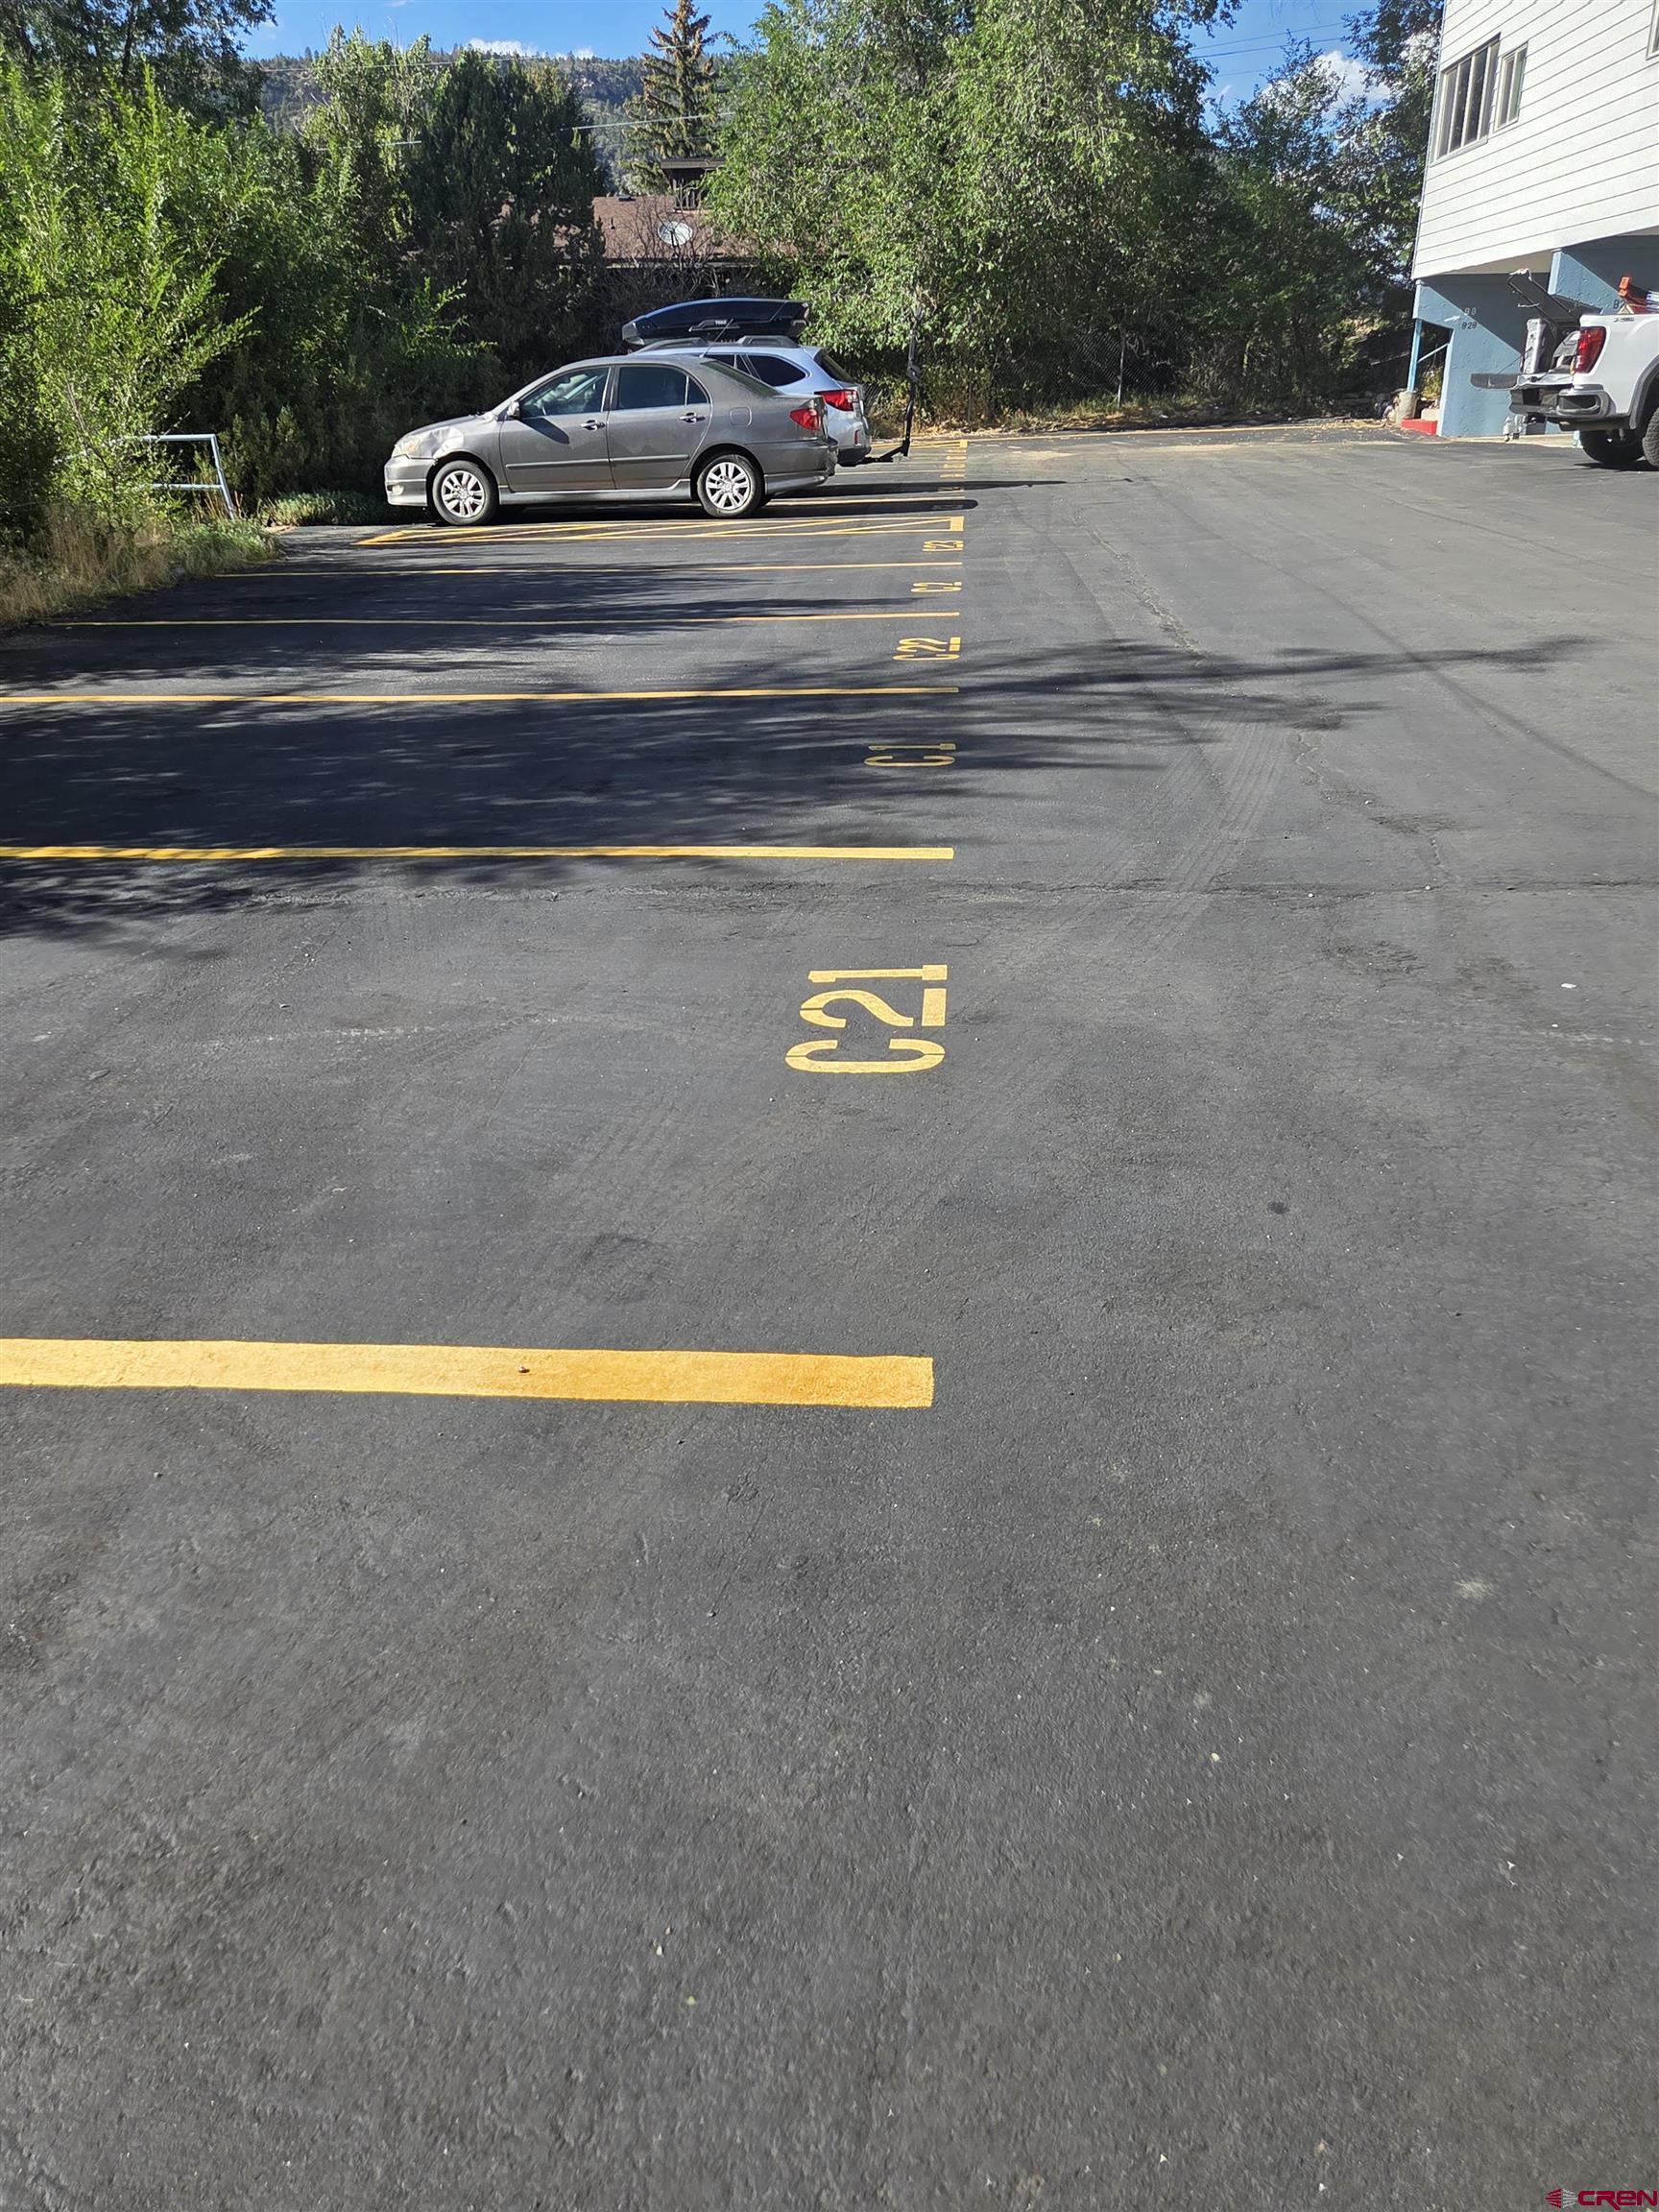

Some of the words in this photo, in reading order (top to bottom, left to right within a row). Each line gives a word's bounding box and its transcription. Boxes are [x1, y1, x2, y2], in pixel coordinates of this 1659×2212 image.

[911, 581, 962, 592] C2
[893, 637, 961, 661] C22
[864, 743, 956, 766] C1
[785, 964, 948, 1072] C21
